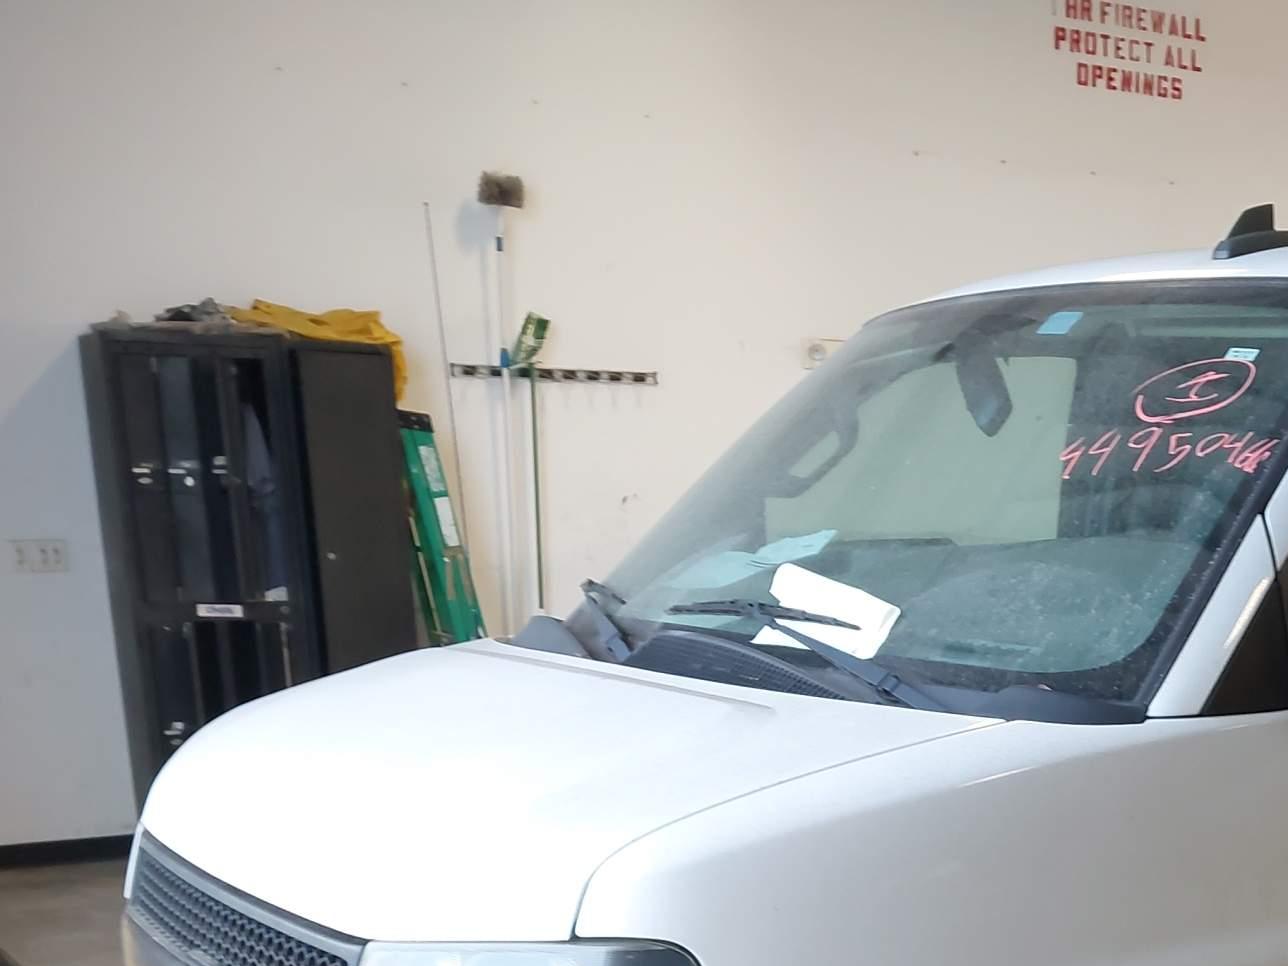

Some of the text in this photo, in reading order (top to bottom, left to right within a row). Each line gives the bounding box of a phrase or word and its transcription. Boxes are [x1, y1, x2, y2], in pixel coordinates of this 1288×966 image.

[1066, 0, 1093, 22] HR
[1100, 2, 1207, 42] FIREWALL
[1054, 26, 1203, 73] PROTECT ALL
[1076, 62, 1183, 100] OPENINGS
